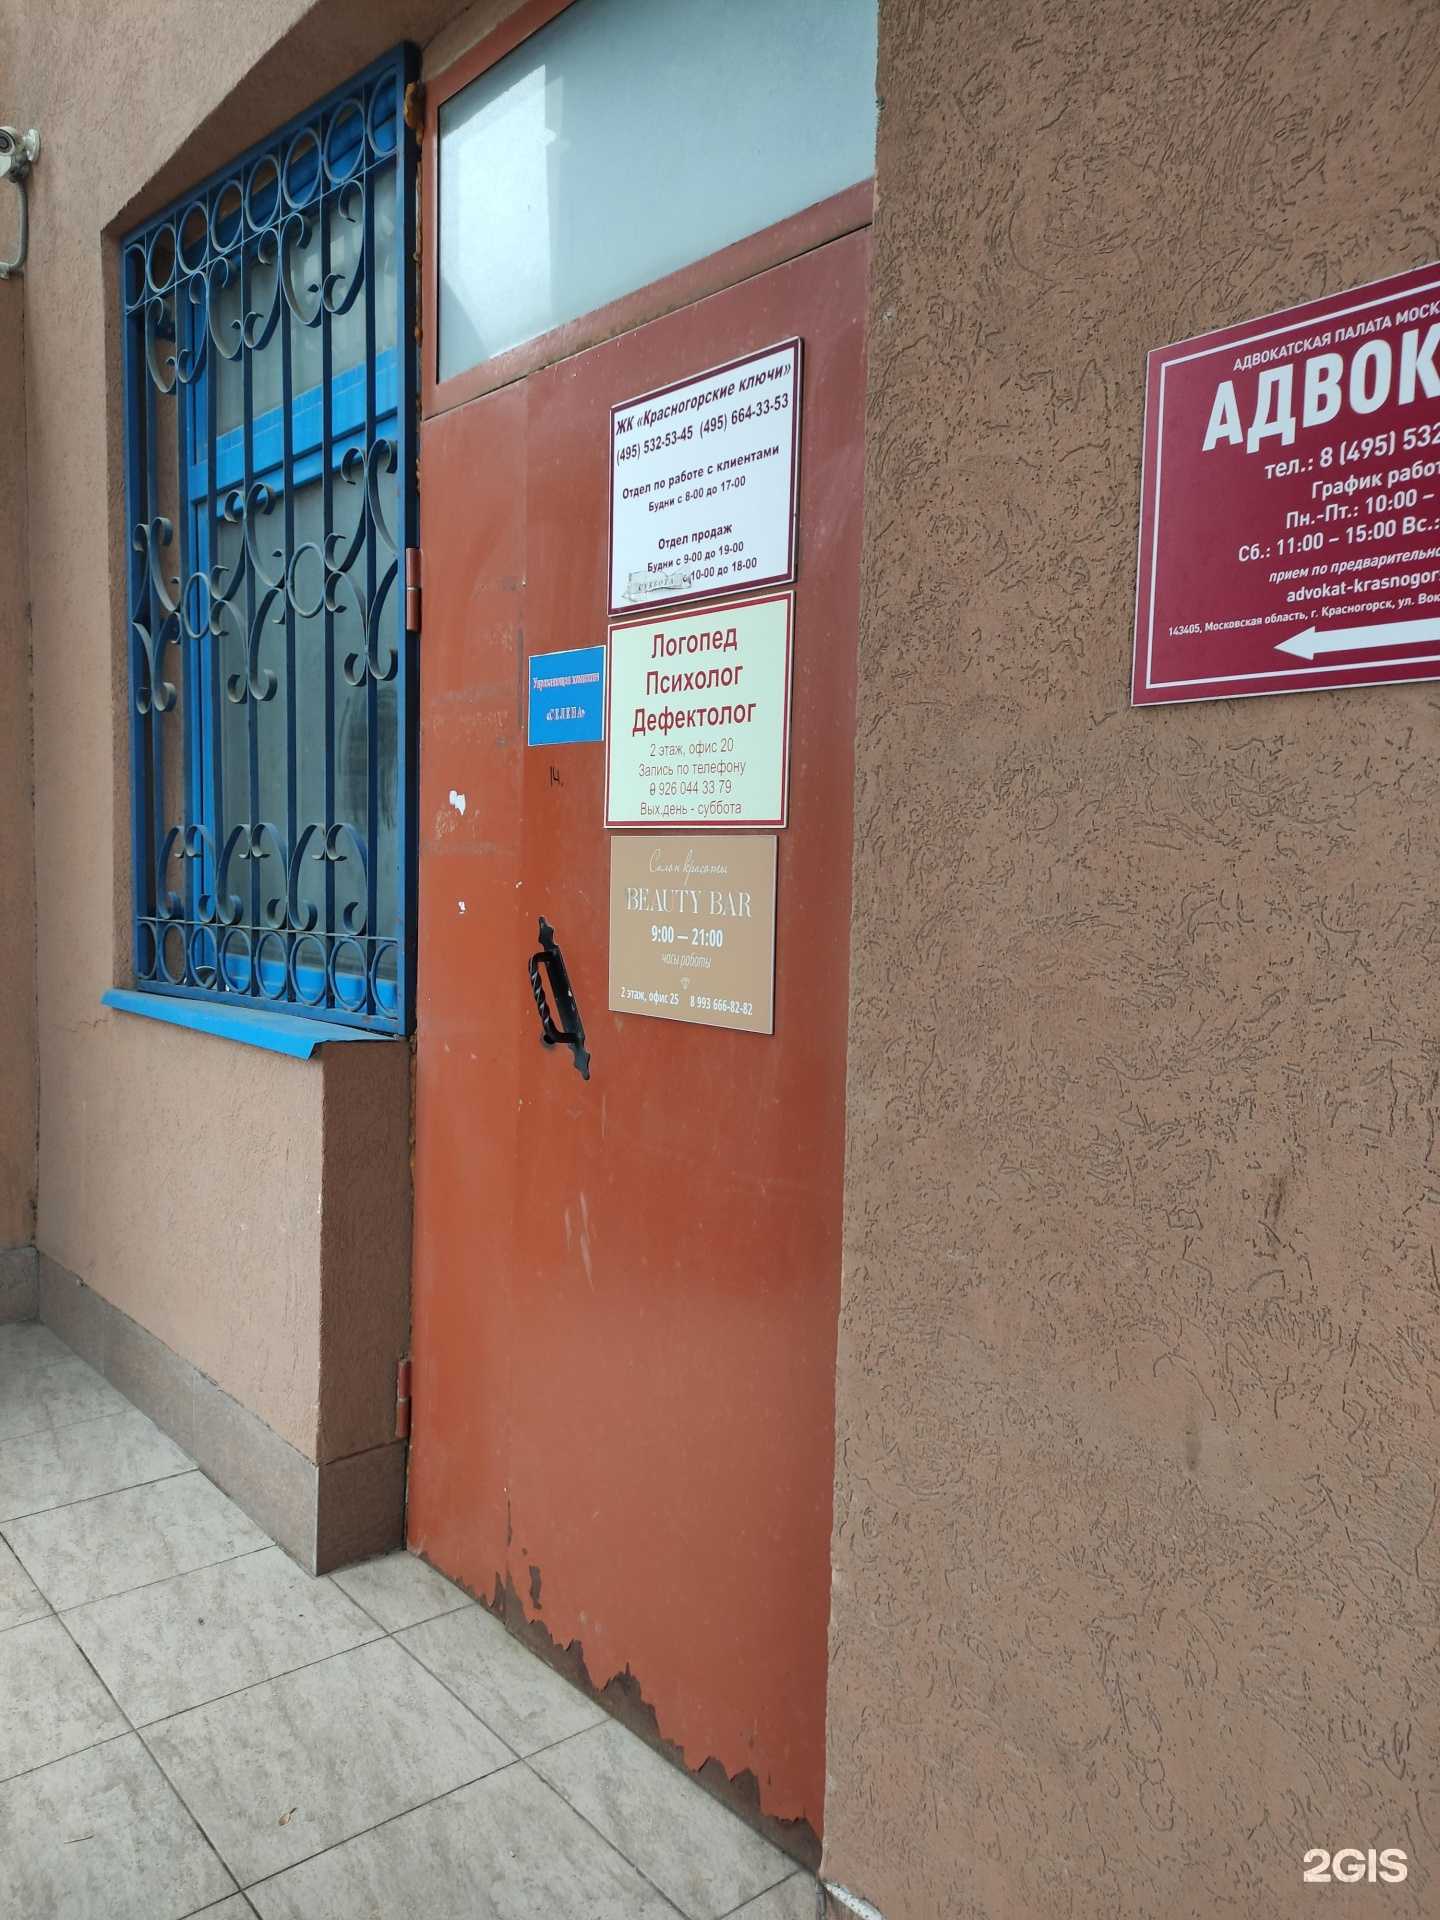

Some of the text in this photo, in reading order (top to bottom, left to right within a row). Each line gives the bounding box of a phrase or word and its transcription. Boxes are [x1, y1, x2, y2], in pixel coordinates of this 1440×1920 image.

[1233, 301, 1440, 371] АДВОКАТСКАЯ ПАЛАТА МОСК
[616, 364, 791, 435] ЖК «Красногорские ключи»
[1202, 322, 1440, 454] АДВОК
[616, 393, 789, 465] (495) 532-53-45 (495) 664-33-53
[1265, 422, 1440, 480] тел.: 8 (495) 532
[622, 446, 779, 500] Отдел по работе с клиентами
[1312, 473, 1382, 500] График
[649, 476, 746, 512] Будни с 8-00 до 17-00
[1286, 503, 1358, 529] Пн.-Пт.:
[1366, 489, 1417, 514] 10:00
[658, 523, 732, 550] Отдел продаж
[1239, 544, 1270, 562] Сб.:
[1277, 532, 1323, 556] 11:00
[1346, 520, 1396, 544] 15:00
[647, 541, 744, 574] Будни с 9-00 до 19-00
[690, 567, 715, 580] 10-00
[717, 566, 728, 578] до
[732, 558, 757, 572] 18-00
[1269, 568, 1308, 584] прием
[1312, 565, 1328, 576] по
[1287, 570, 1440, 602] advokat-krasnogor
[1169, 623, 1202, 637] 143405,
[1205, 617, 1262, 632] Московская
[1265, 611, 1308, 625] область,
[1311, 610, 1318, 618] г.
[1322, 599, 1395, 618] Красногорск,
[1398, 596, 1414, 609] ул.
[652, 628, 737, 658] Логопед
[647, 666, 743, 695] Психолог
[632, 703, 756, 736] Дефектолог
[650, 737, 734, 758] 2 этаж, офис 20
[639, 760, 746, 776] Запись по телефону
[659, 782, 677, 795] 926
[680, 781, 698, 795] 044
[703, 780, 715, 794] 33
[719, 780, 732, 793] 79
[640, 802, 687, 818] Вых.день
[698, 800, 742, 818] суббота
[626, 887, 752, 917] BEAUTY BAR
[651, 925, 674, 943] 9:00
[692, 928, 723, 947] 21:00
[621, 987, 752, 1016] 2 этаж, офис 25 8 993 666-82-82
